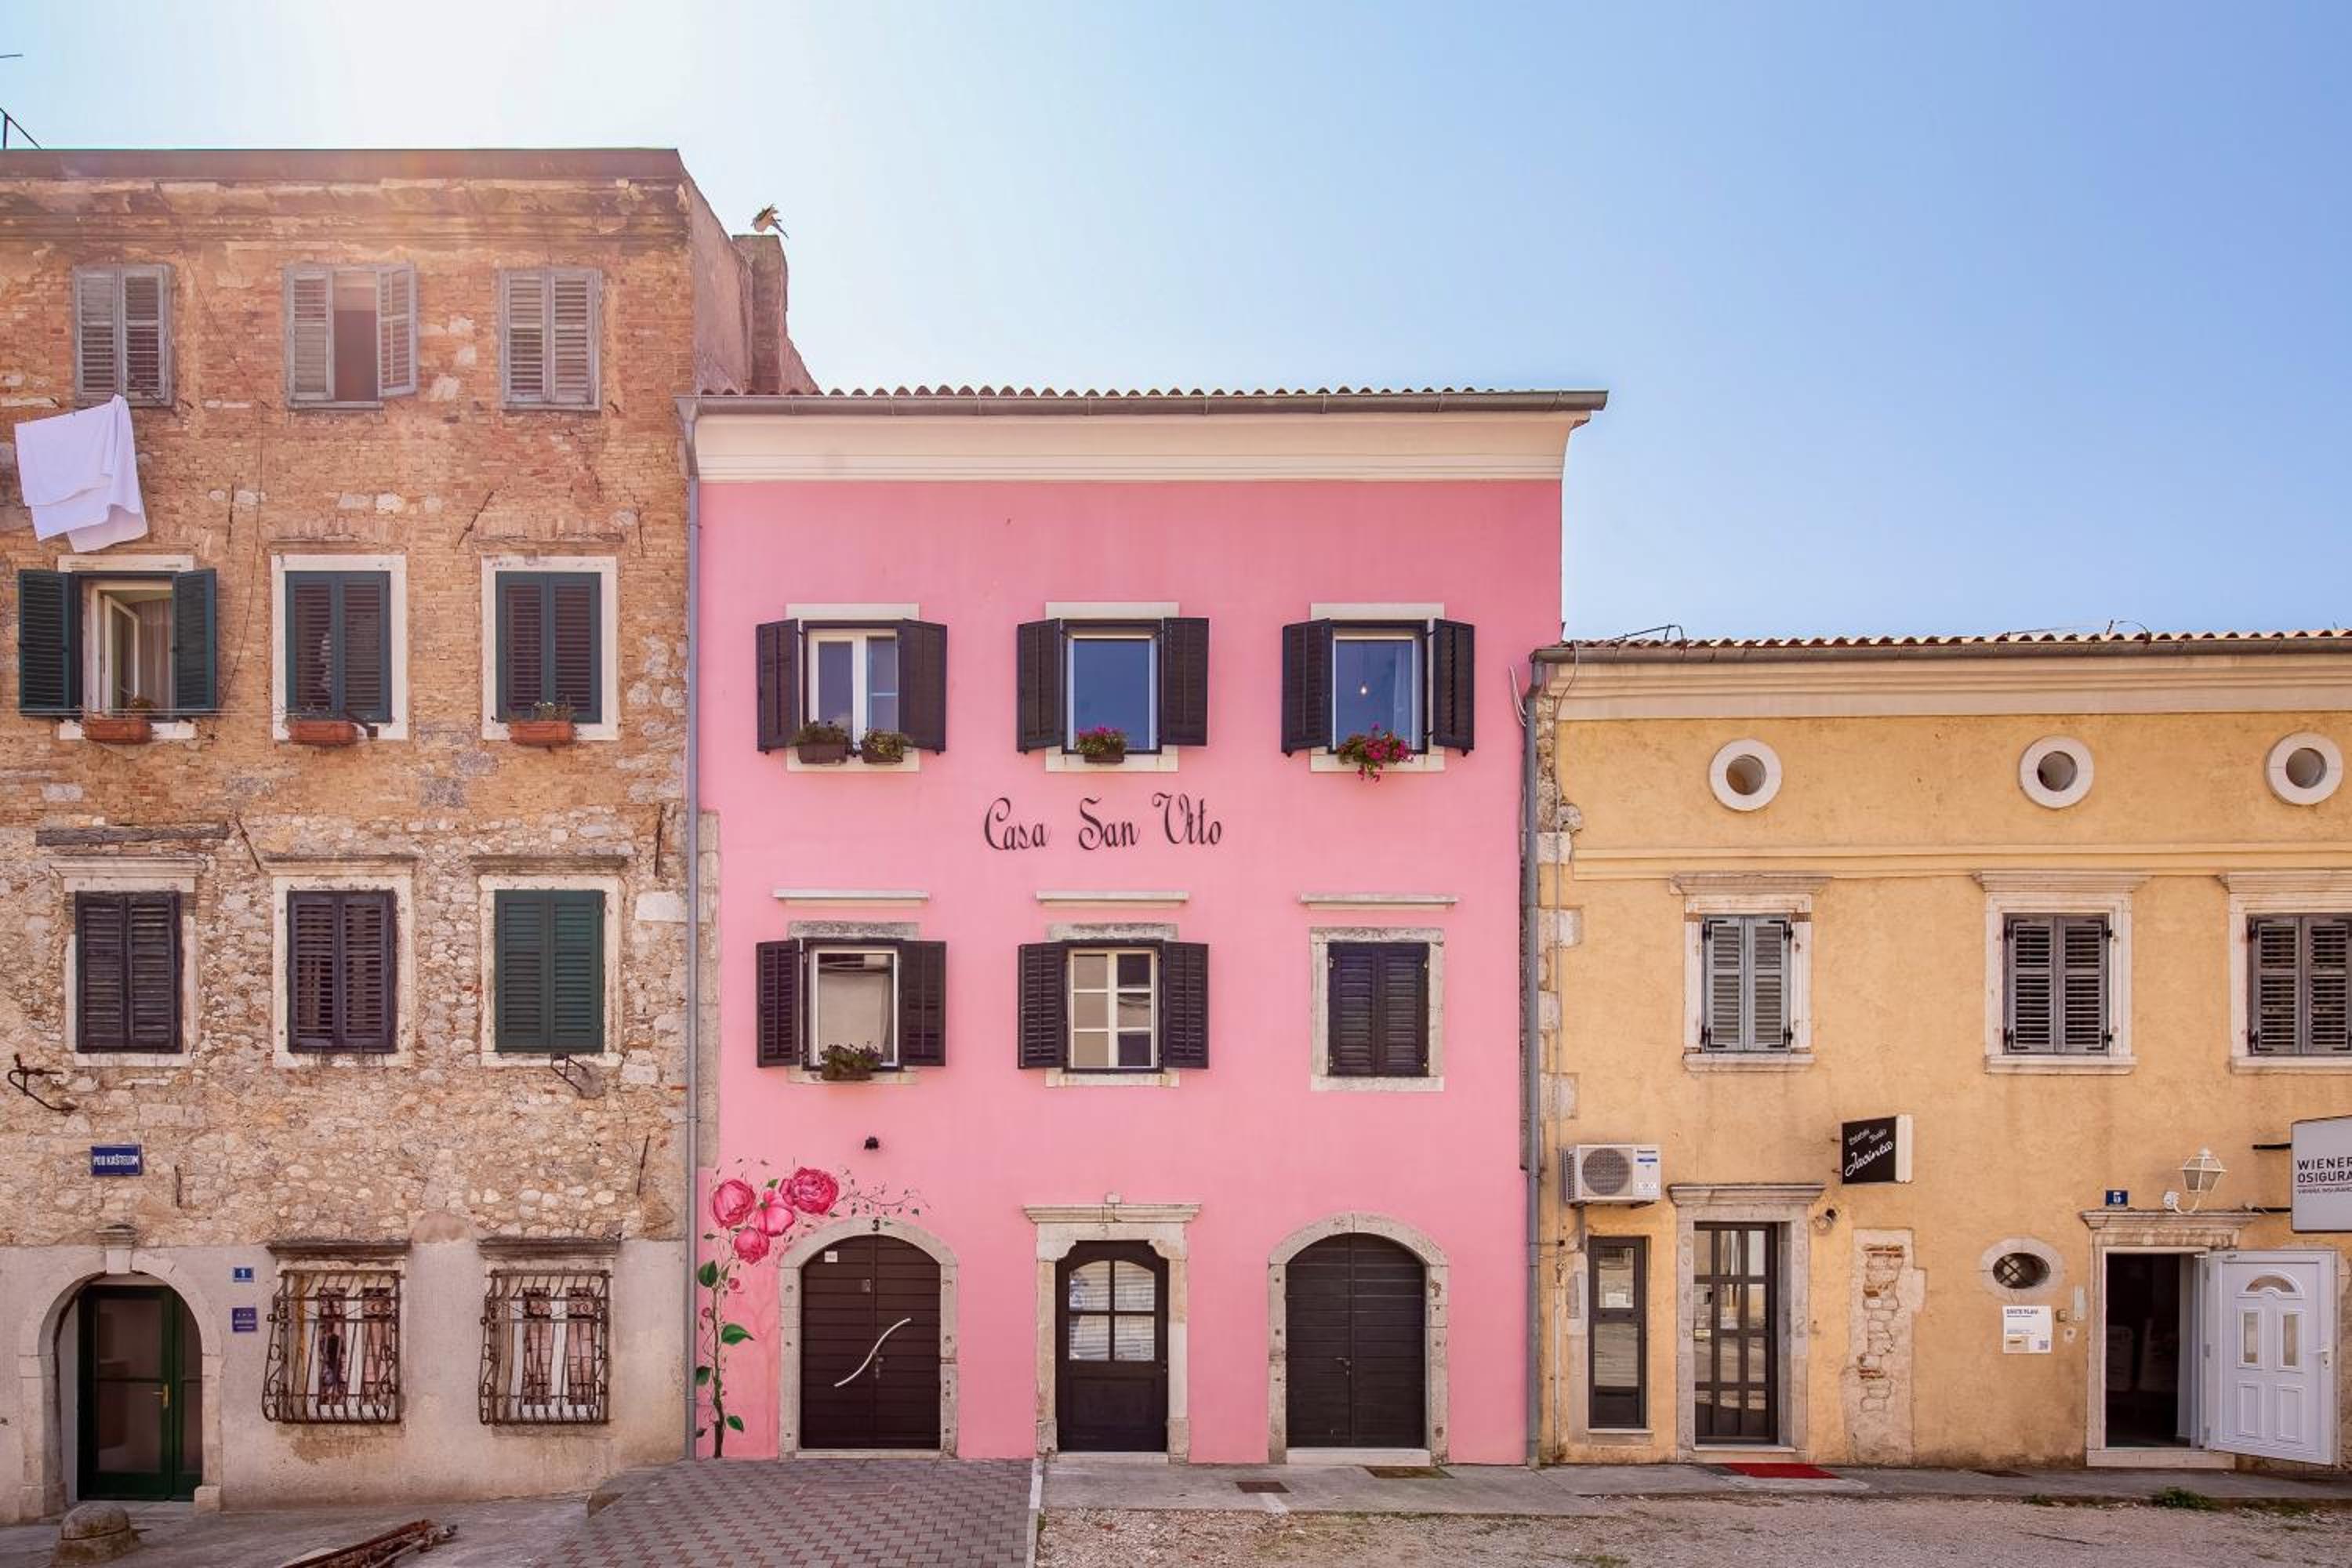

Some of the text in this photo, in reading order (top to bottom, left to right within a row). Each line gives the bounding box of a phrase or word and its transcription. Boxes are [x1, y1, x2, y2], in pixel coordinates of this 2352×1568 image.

[984, 792, 1222, 851] Casa San Vito
[2113, 1191, 2122, 1203] 5
[871, 1219, 880, 1232] 3
